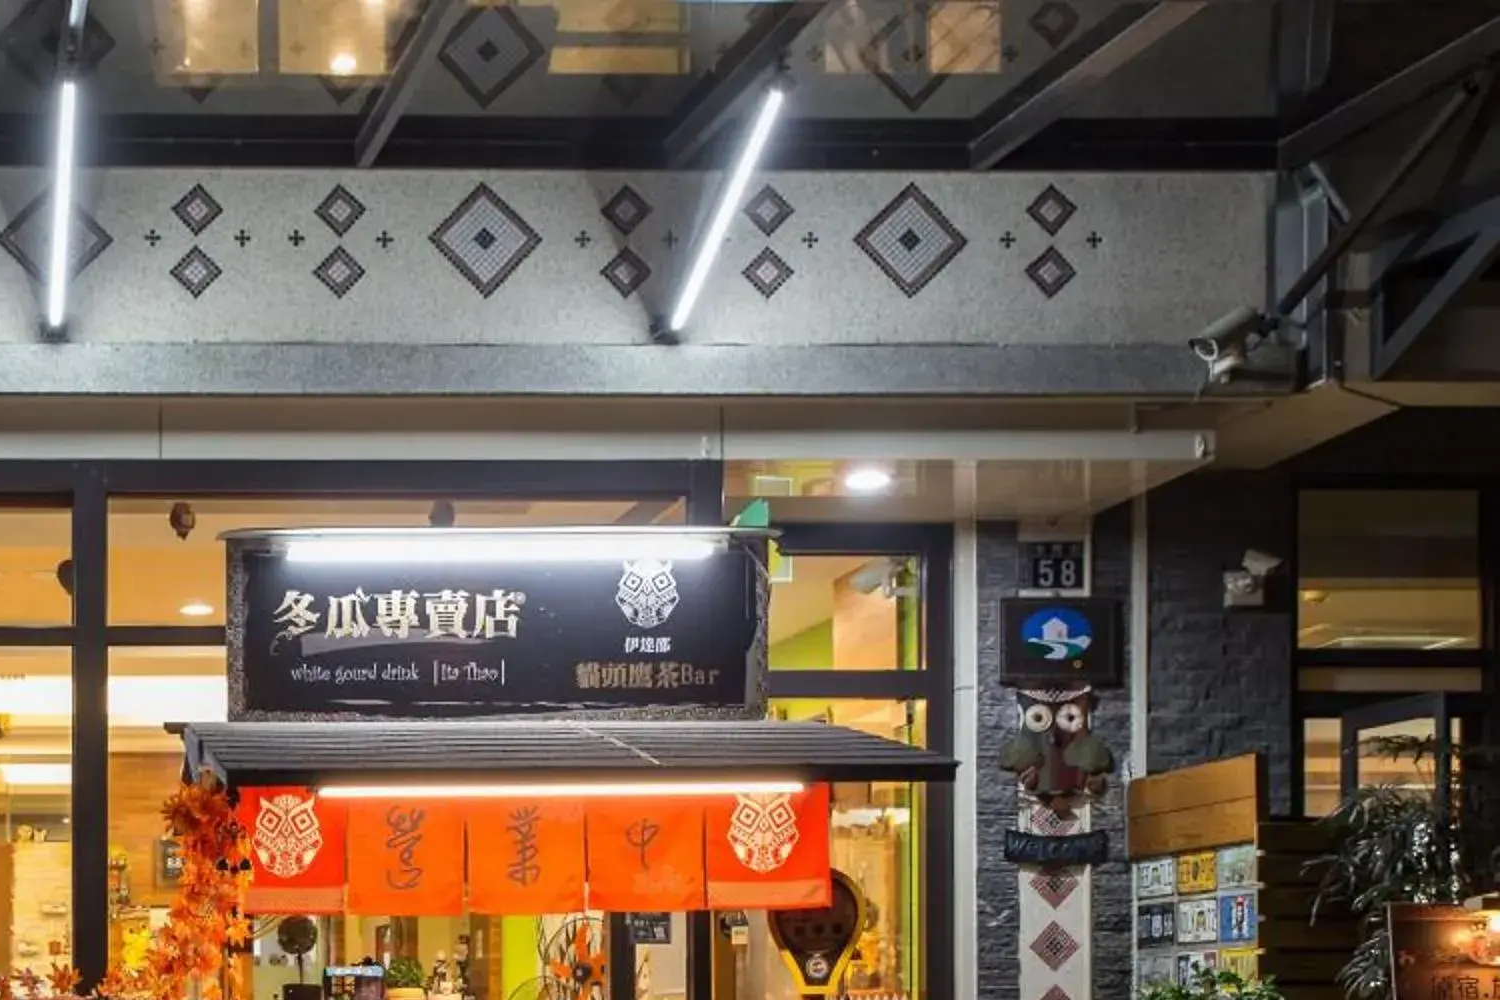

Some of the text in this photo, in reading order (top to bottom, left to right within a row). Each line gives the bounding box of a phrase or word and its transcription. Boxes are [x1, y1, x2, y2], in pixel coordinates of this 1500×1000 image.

[1037, 559, 1077, 587] 58
[273, 587, 520, 639] 冬瓜專賣店
[291, 662, 331, 684] white
[335, 662, 377, 684] gourd
[381, 661, 420, 682] drink
